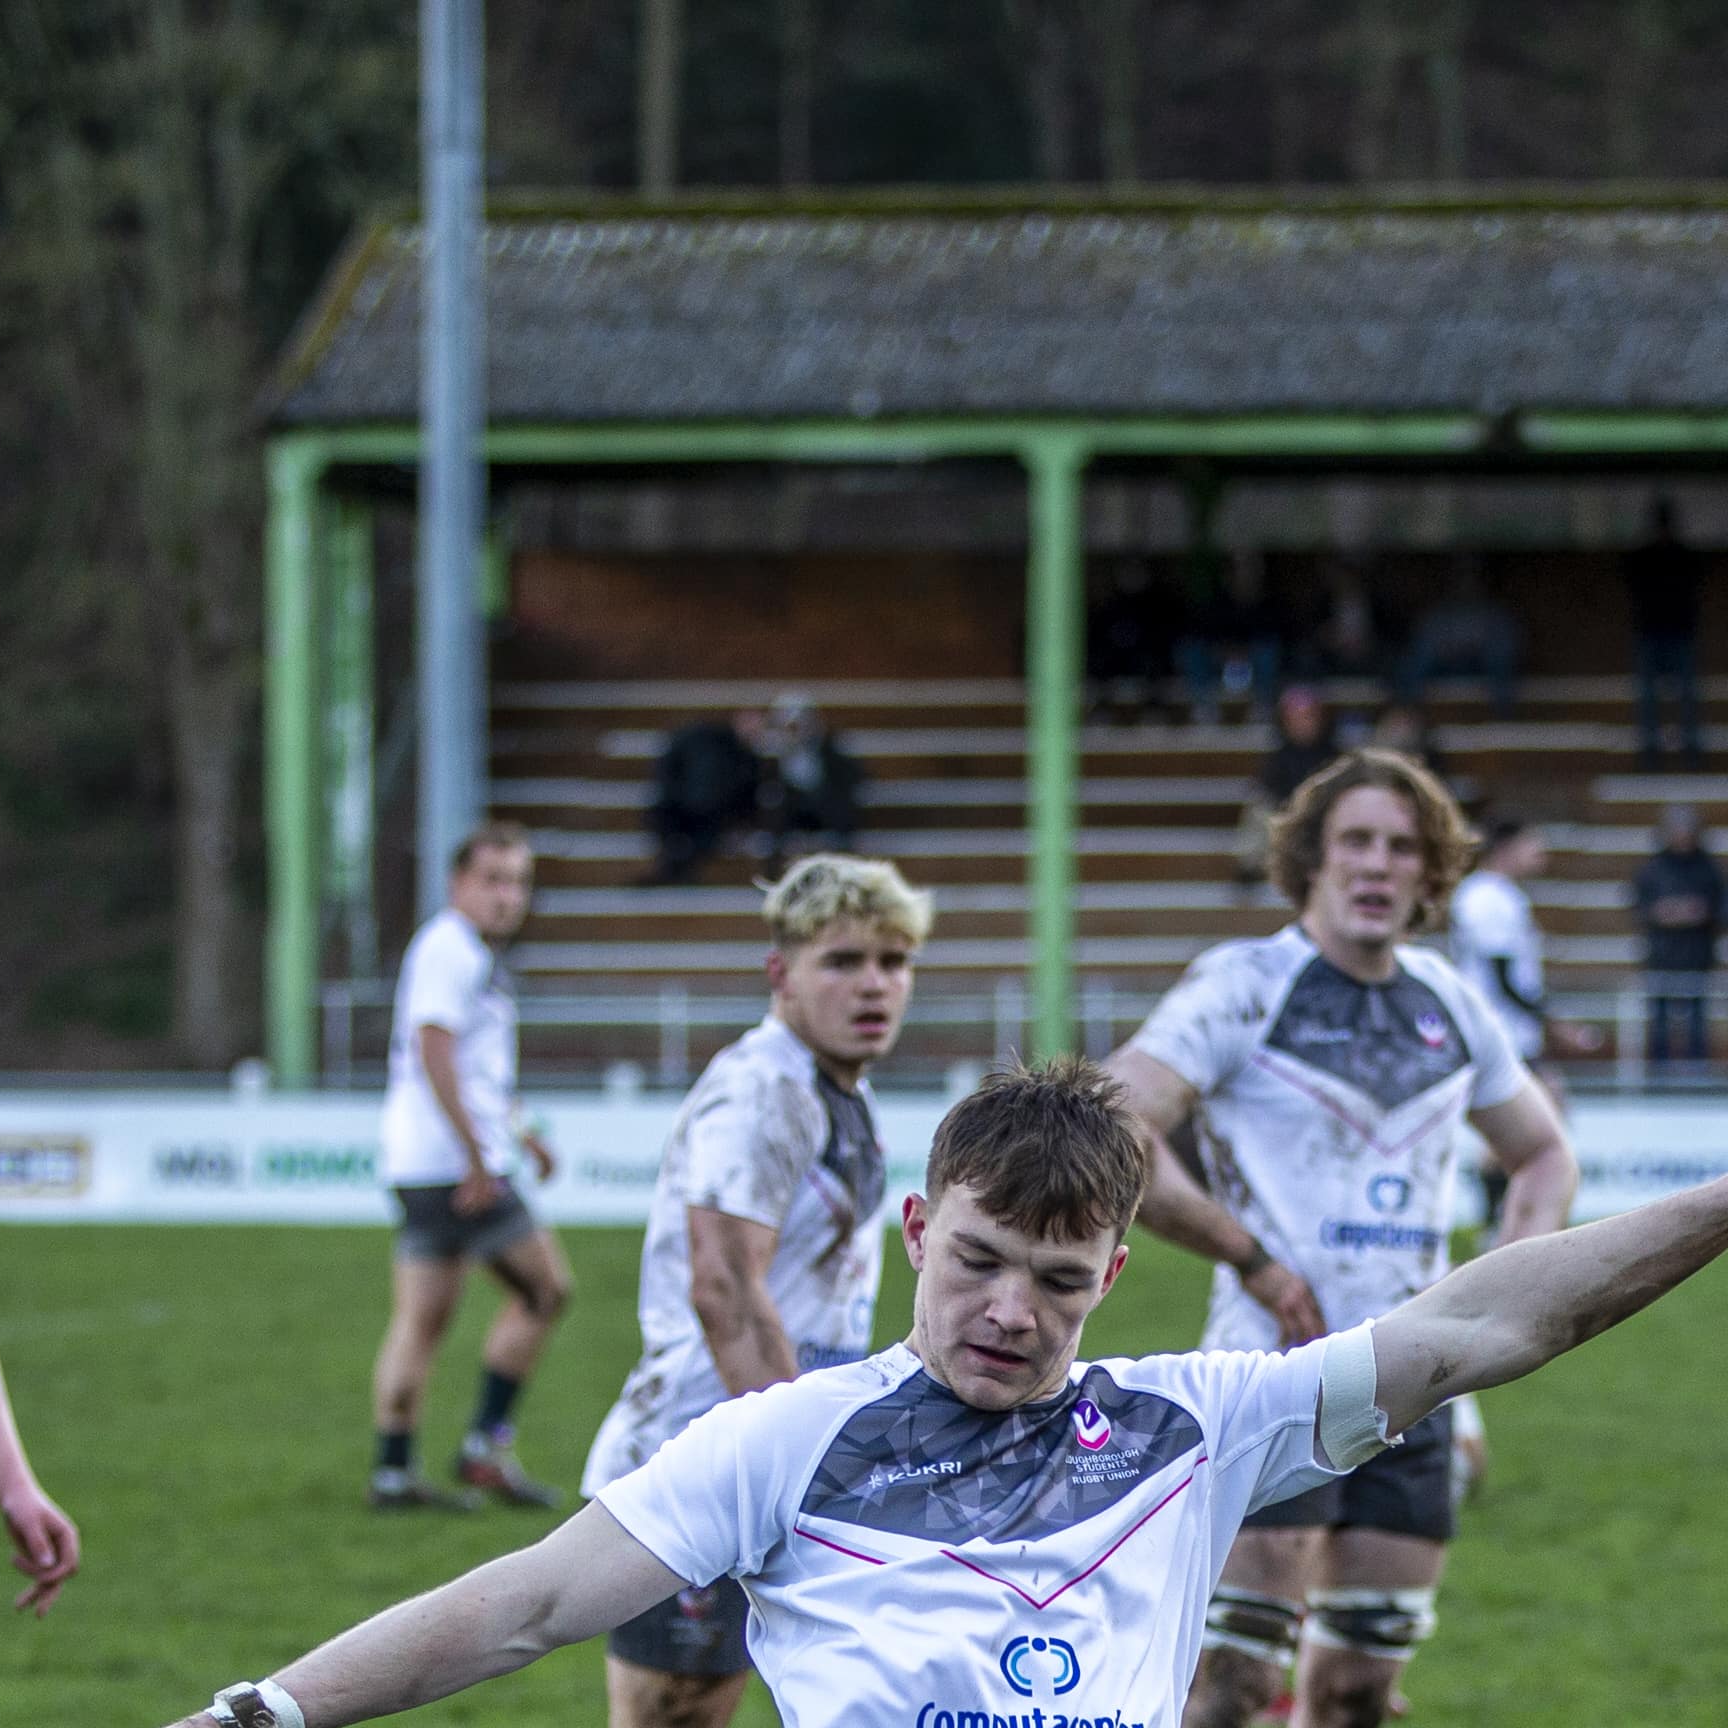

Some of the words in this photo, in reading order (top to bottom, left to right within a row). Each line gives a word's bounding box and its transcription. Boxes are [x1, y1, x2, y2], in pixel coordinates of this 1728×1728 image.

[887, 1461, 962, 1484] KUKRI
[1075, 1459, 1128, 1473] STUDENTS
[1072, 1473, 1105, 1485] RUGBY
[1106, 1468, 1140, 1481] UNION
